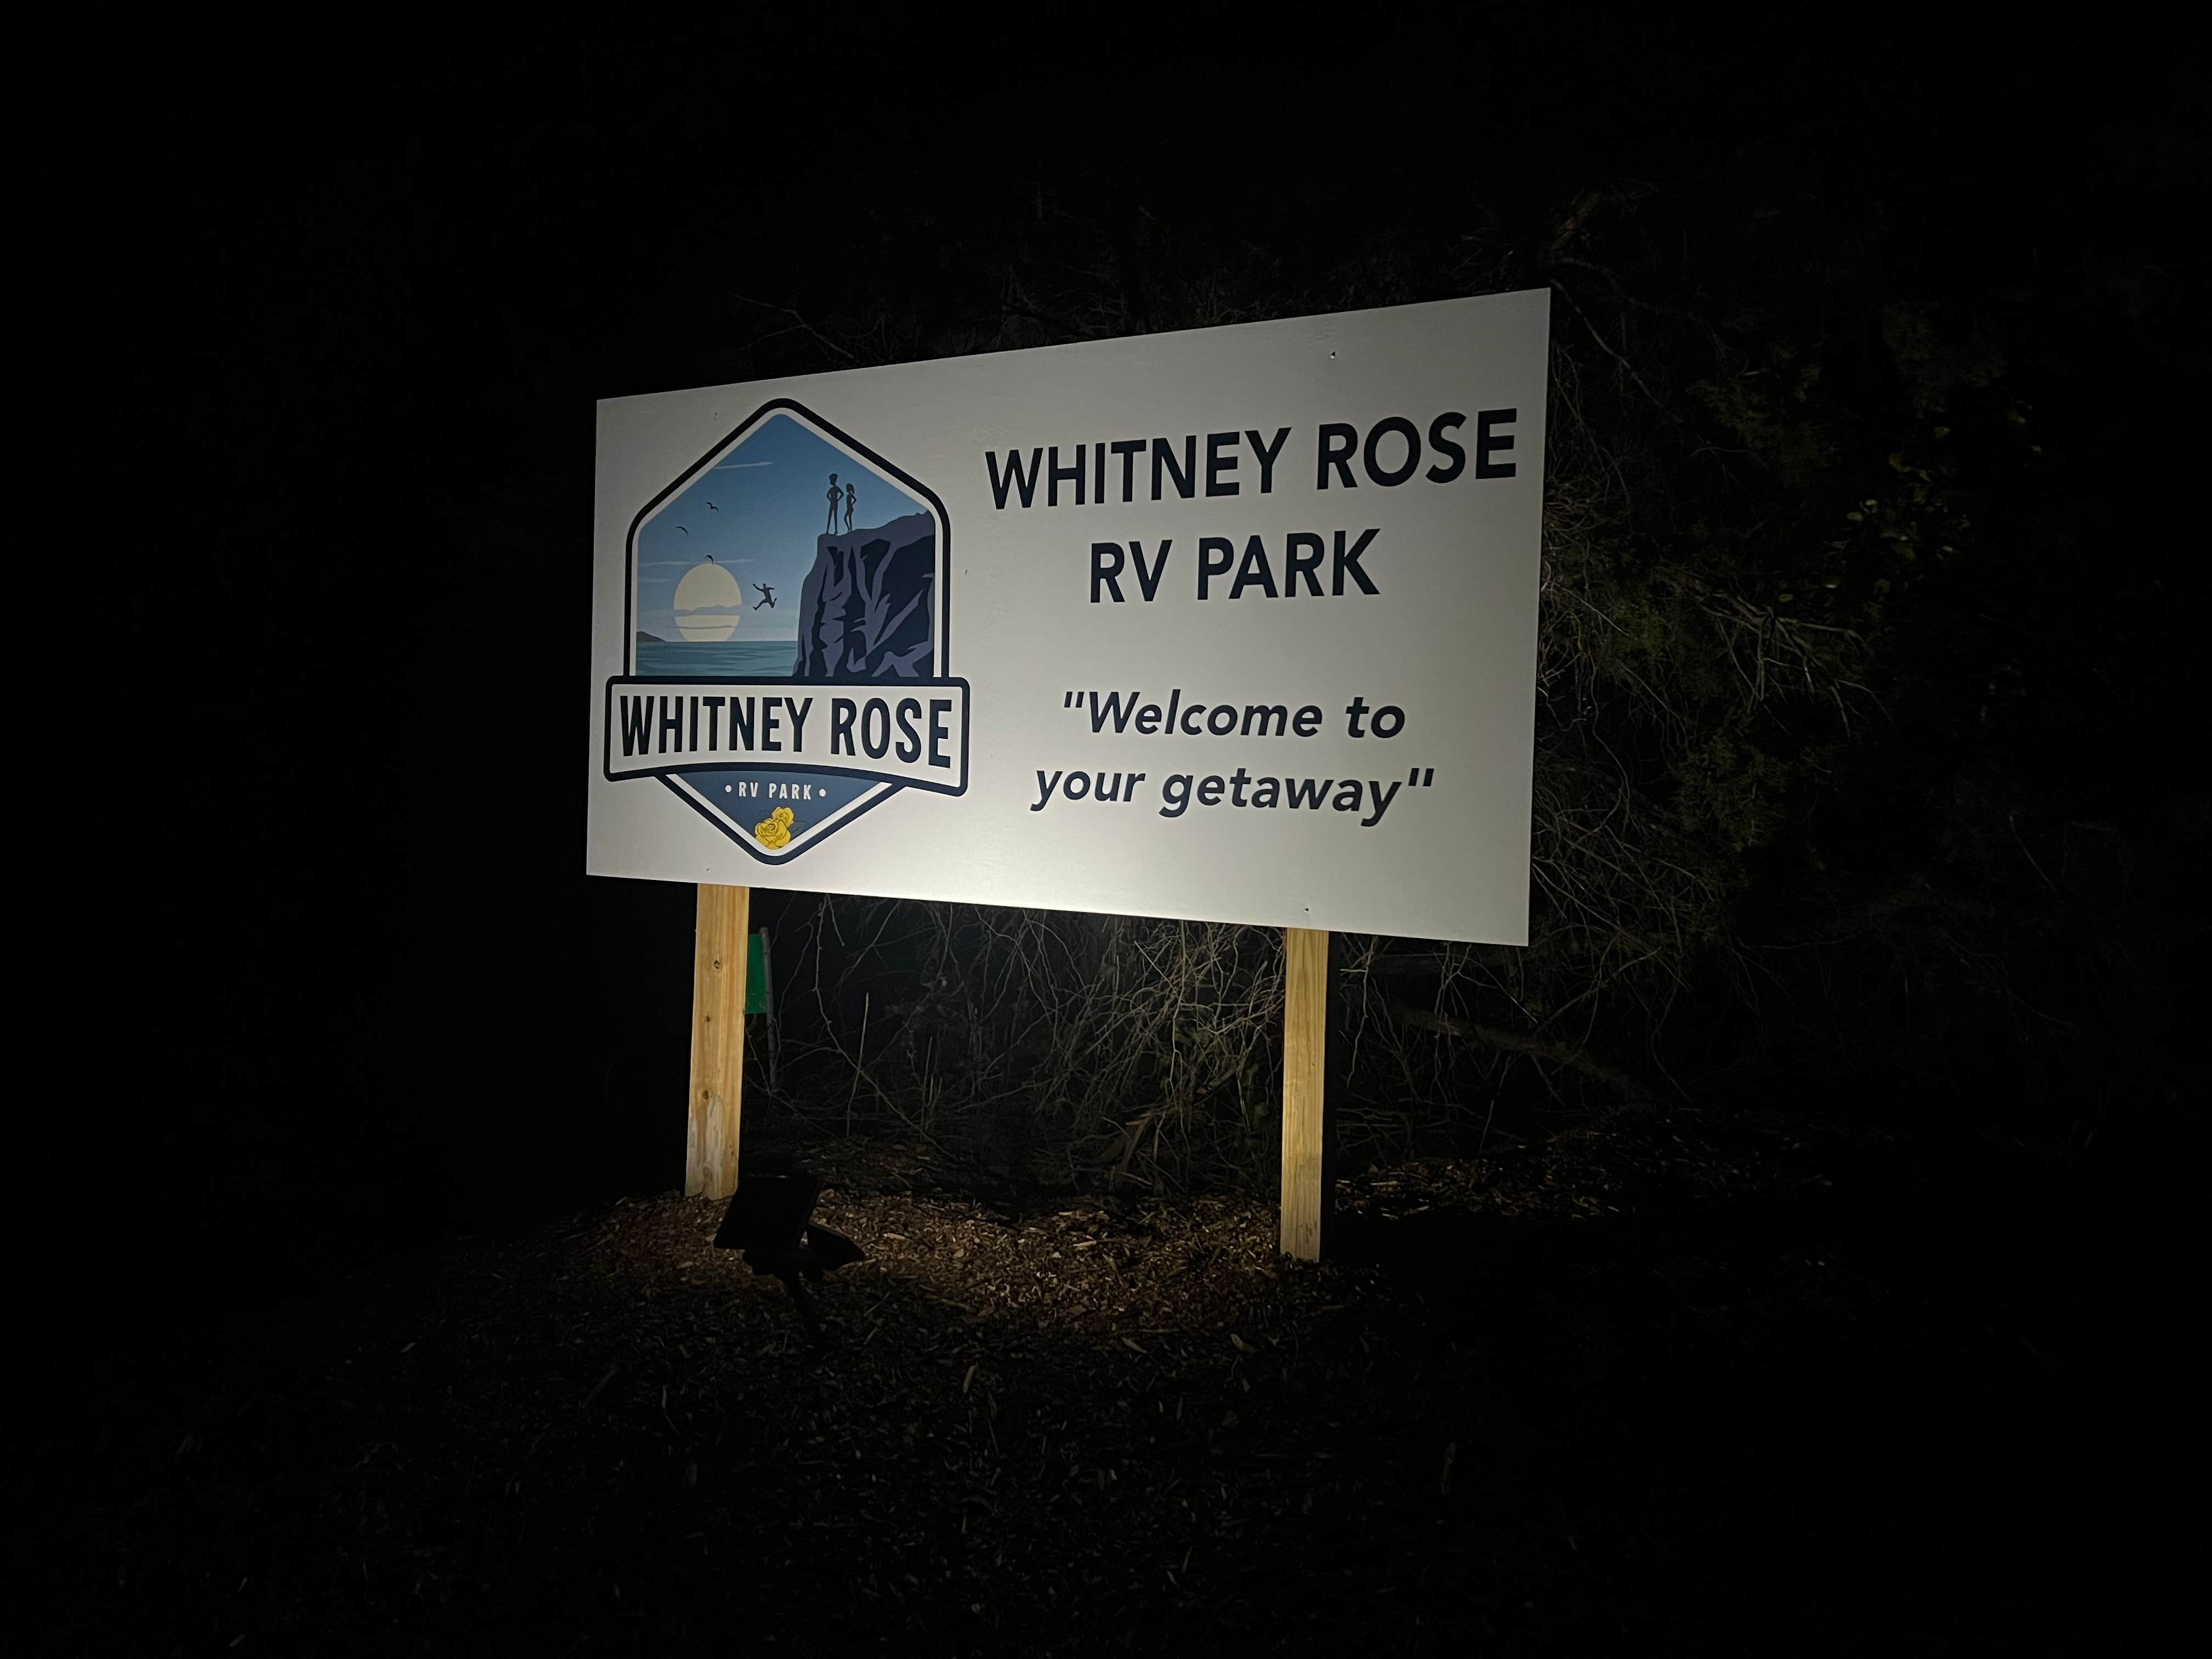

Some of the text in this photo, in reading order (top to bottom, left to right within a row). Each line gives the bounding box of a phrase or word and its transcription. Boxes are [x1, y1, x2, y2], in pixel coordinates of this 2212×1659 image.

[985, 408, 1517, 509] WHITNEY ROSE
[1091, 528, 1380, 603] RV PARK
[620, 696, 952, 768] WHITNEY ROSE
[1064, 689, 1405, 738] "Welcome to
[738, 781, 811, 800] RV PARK
[1030, 768, 1434, 827] your getaway"
